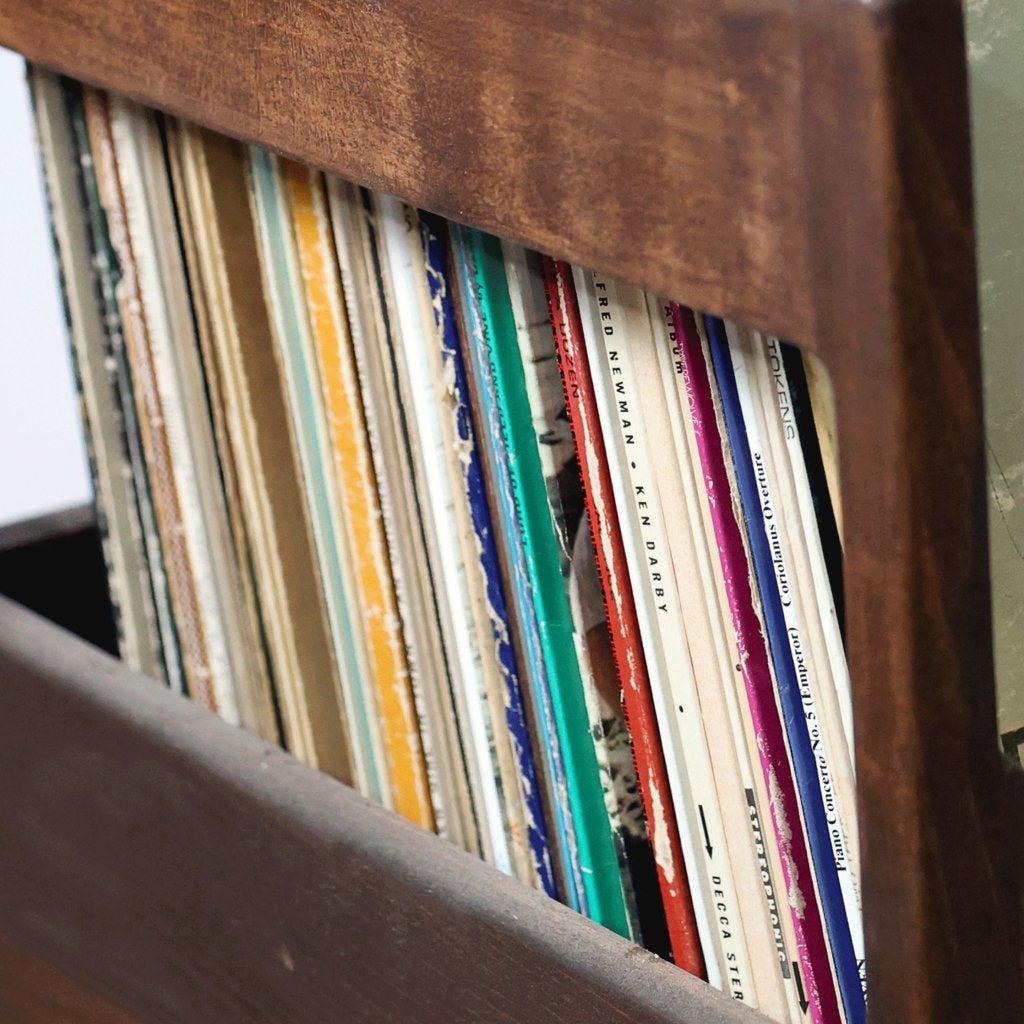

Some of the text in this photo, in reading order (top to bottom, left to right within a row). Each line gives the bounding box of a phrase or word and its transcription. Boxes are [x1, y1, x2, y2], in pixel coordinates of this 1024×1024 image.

[768, 340, 795, 440] TOKENS
[754, 453, 773, 520] Overture
[770, 524, 791, 607] Coriolanus
[609, 351, 635, 446] NEWMAN
[635, 485, 650, 527] KEN
[646, 541, 668, 614] DARBY
[712, 876, 731, 939] DECCA
[727, 953, 744, 1002] STER
[788, 627, 814, 706] (Emperor)
[810, 725, 822, 751] No.
[819, 756, 836, 825] Concerto
[832, 829, 846, 871] Piano
